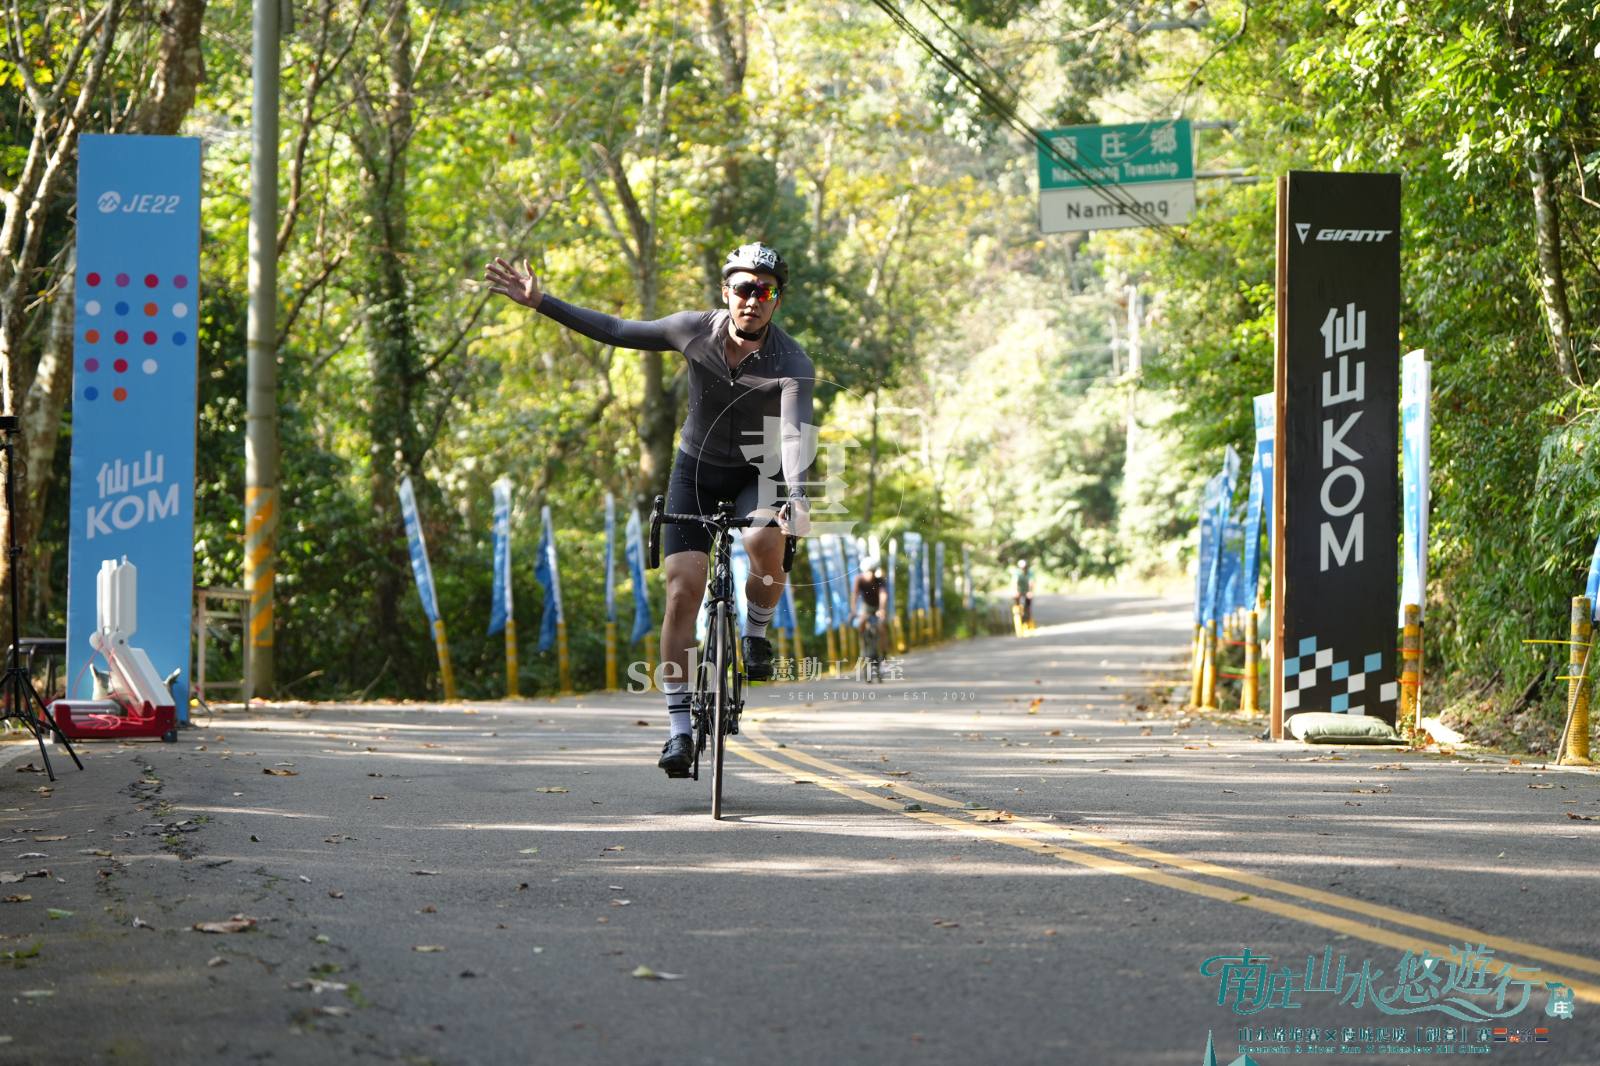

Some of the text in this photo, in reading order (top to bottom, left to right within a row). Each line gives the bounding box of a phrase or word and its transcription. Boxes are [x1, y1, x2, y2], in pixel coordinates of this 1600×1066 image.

[1051, 126, 1177, 161] 南庄鄉
[1123, 159, 1179, 177] Township
[122, 194, 180, 213] JE22
[1316, 229, 1392, 242] GIANT
[96, 450, 164, 499] 仙山
[86, 482, 179, 540] KOM
